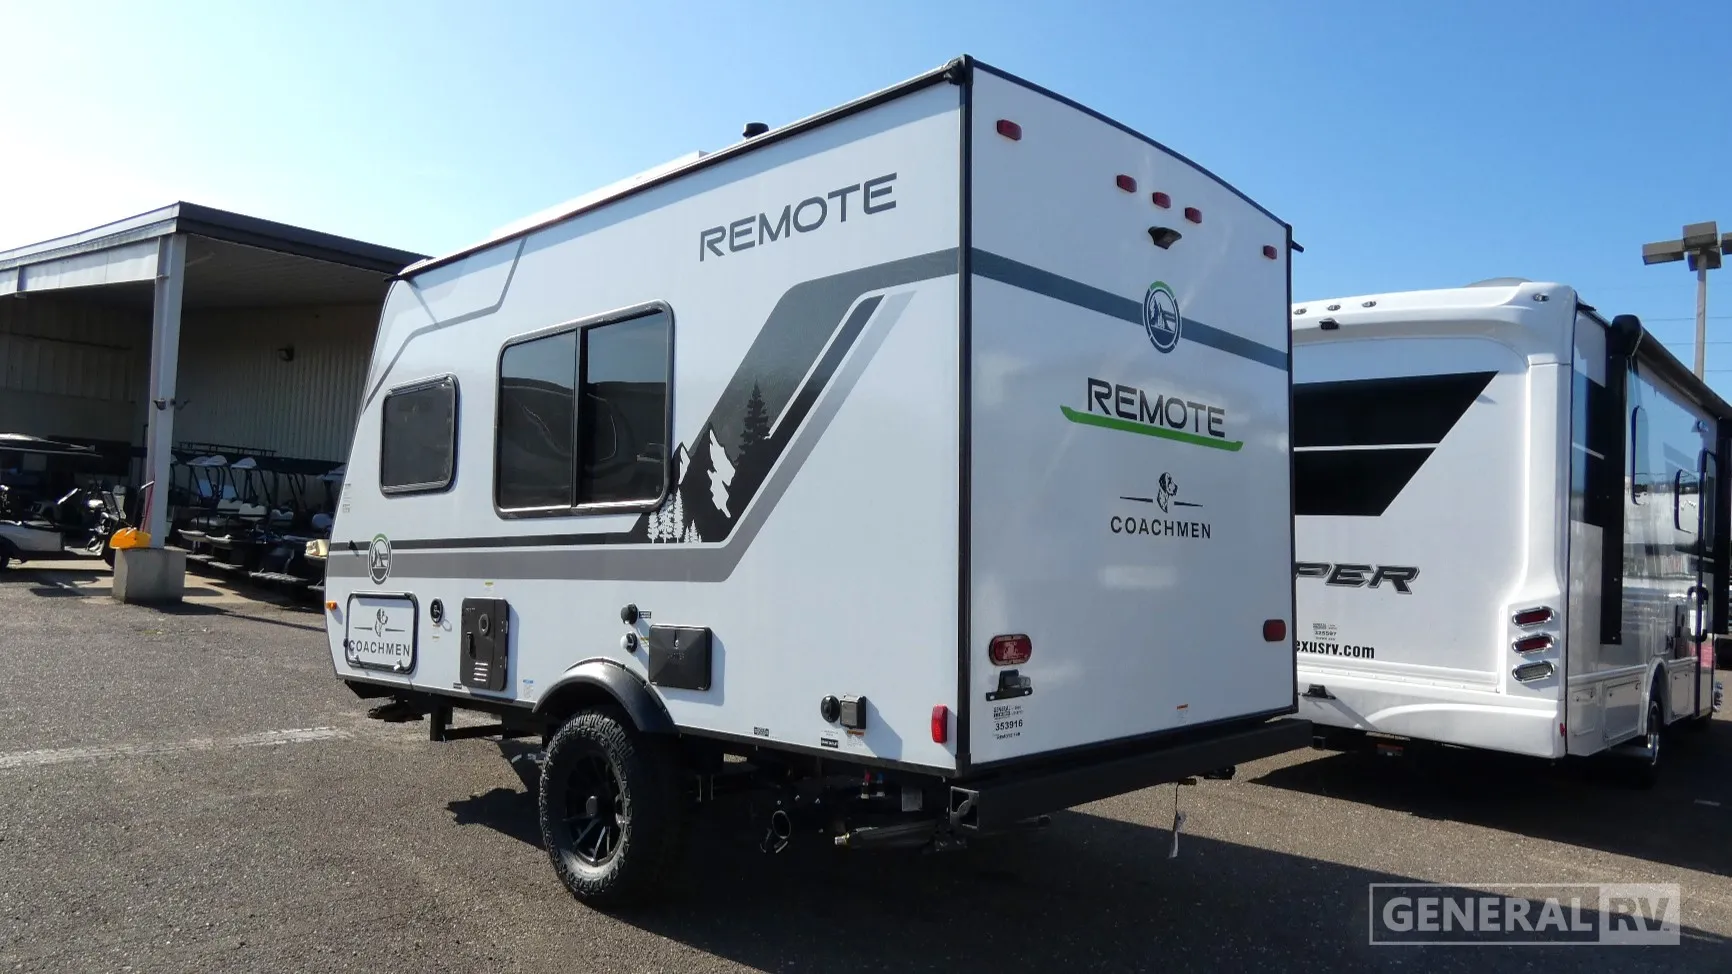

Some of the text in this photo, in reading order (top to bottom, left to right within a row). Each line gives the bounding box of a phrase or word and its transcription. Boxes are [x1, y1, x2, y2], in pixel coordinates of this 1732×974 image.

[699, 172, 897, 262] REMOTE
[1087, 376, 1226, 438] REMOTE
[1110, 515, 1211, 539] COACHMEN
[348, 639, 410, 657] COACHMEN
[995, 719, 1023, 731] 353916
